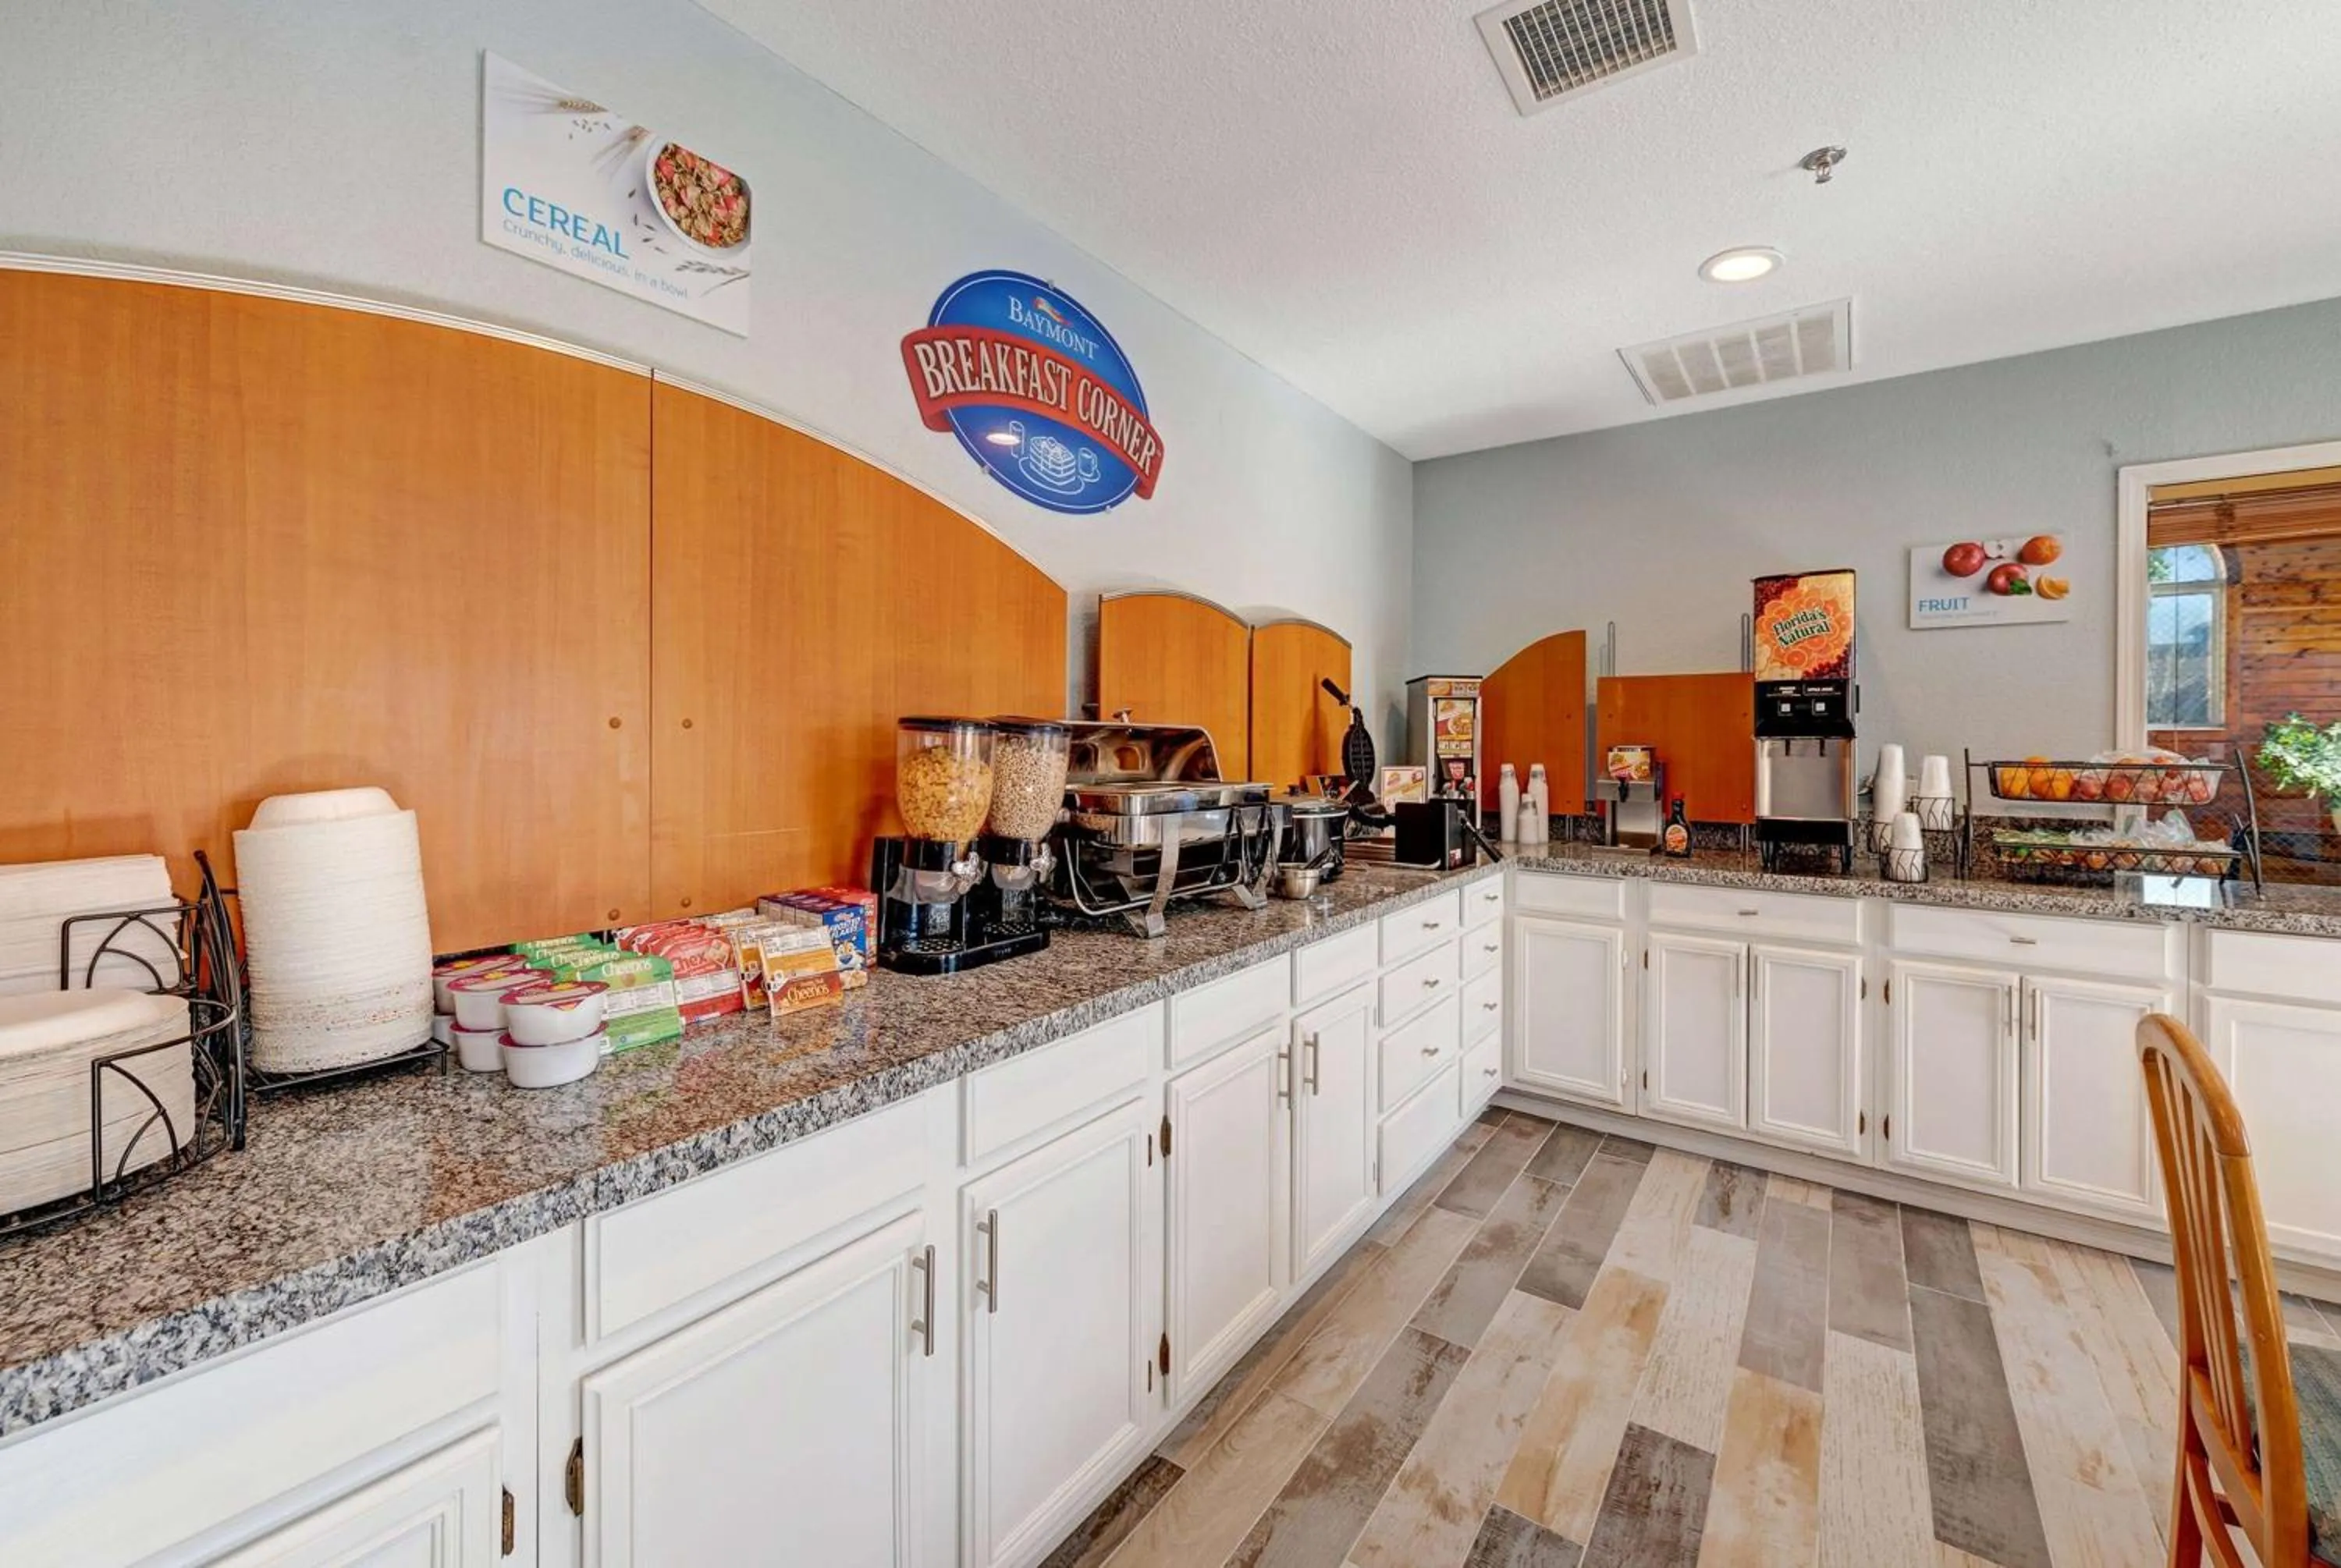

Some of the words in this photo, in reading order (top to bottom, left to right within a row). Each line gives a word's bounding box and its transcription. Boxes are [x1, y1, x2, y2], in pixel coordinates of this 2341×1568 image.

[503, 187, 630, 260] CEREAL
[503, 218, 567, 255] Crunchy,
[660, 277, 688, 299] bowl
[914, 339, 1071, 412] BREAKFAST
[1077, 377, 1159, 475] CORNER
[1919, 597, 1970, 612] FRUIT
[1773, 608, 1827, 636] Florida's
[1778, 620, 1831, 646] Natural
[787, 983, 830, 1003] Cheerios
